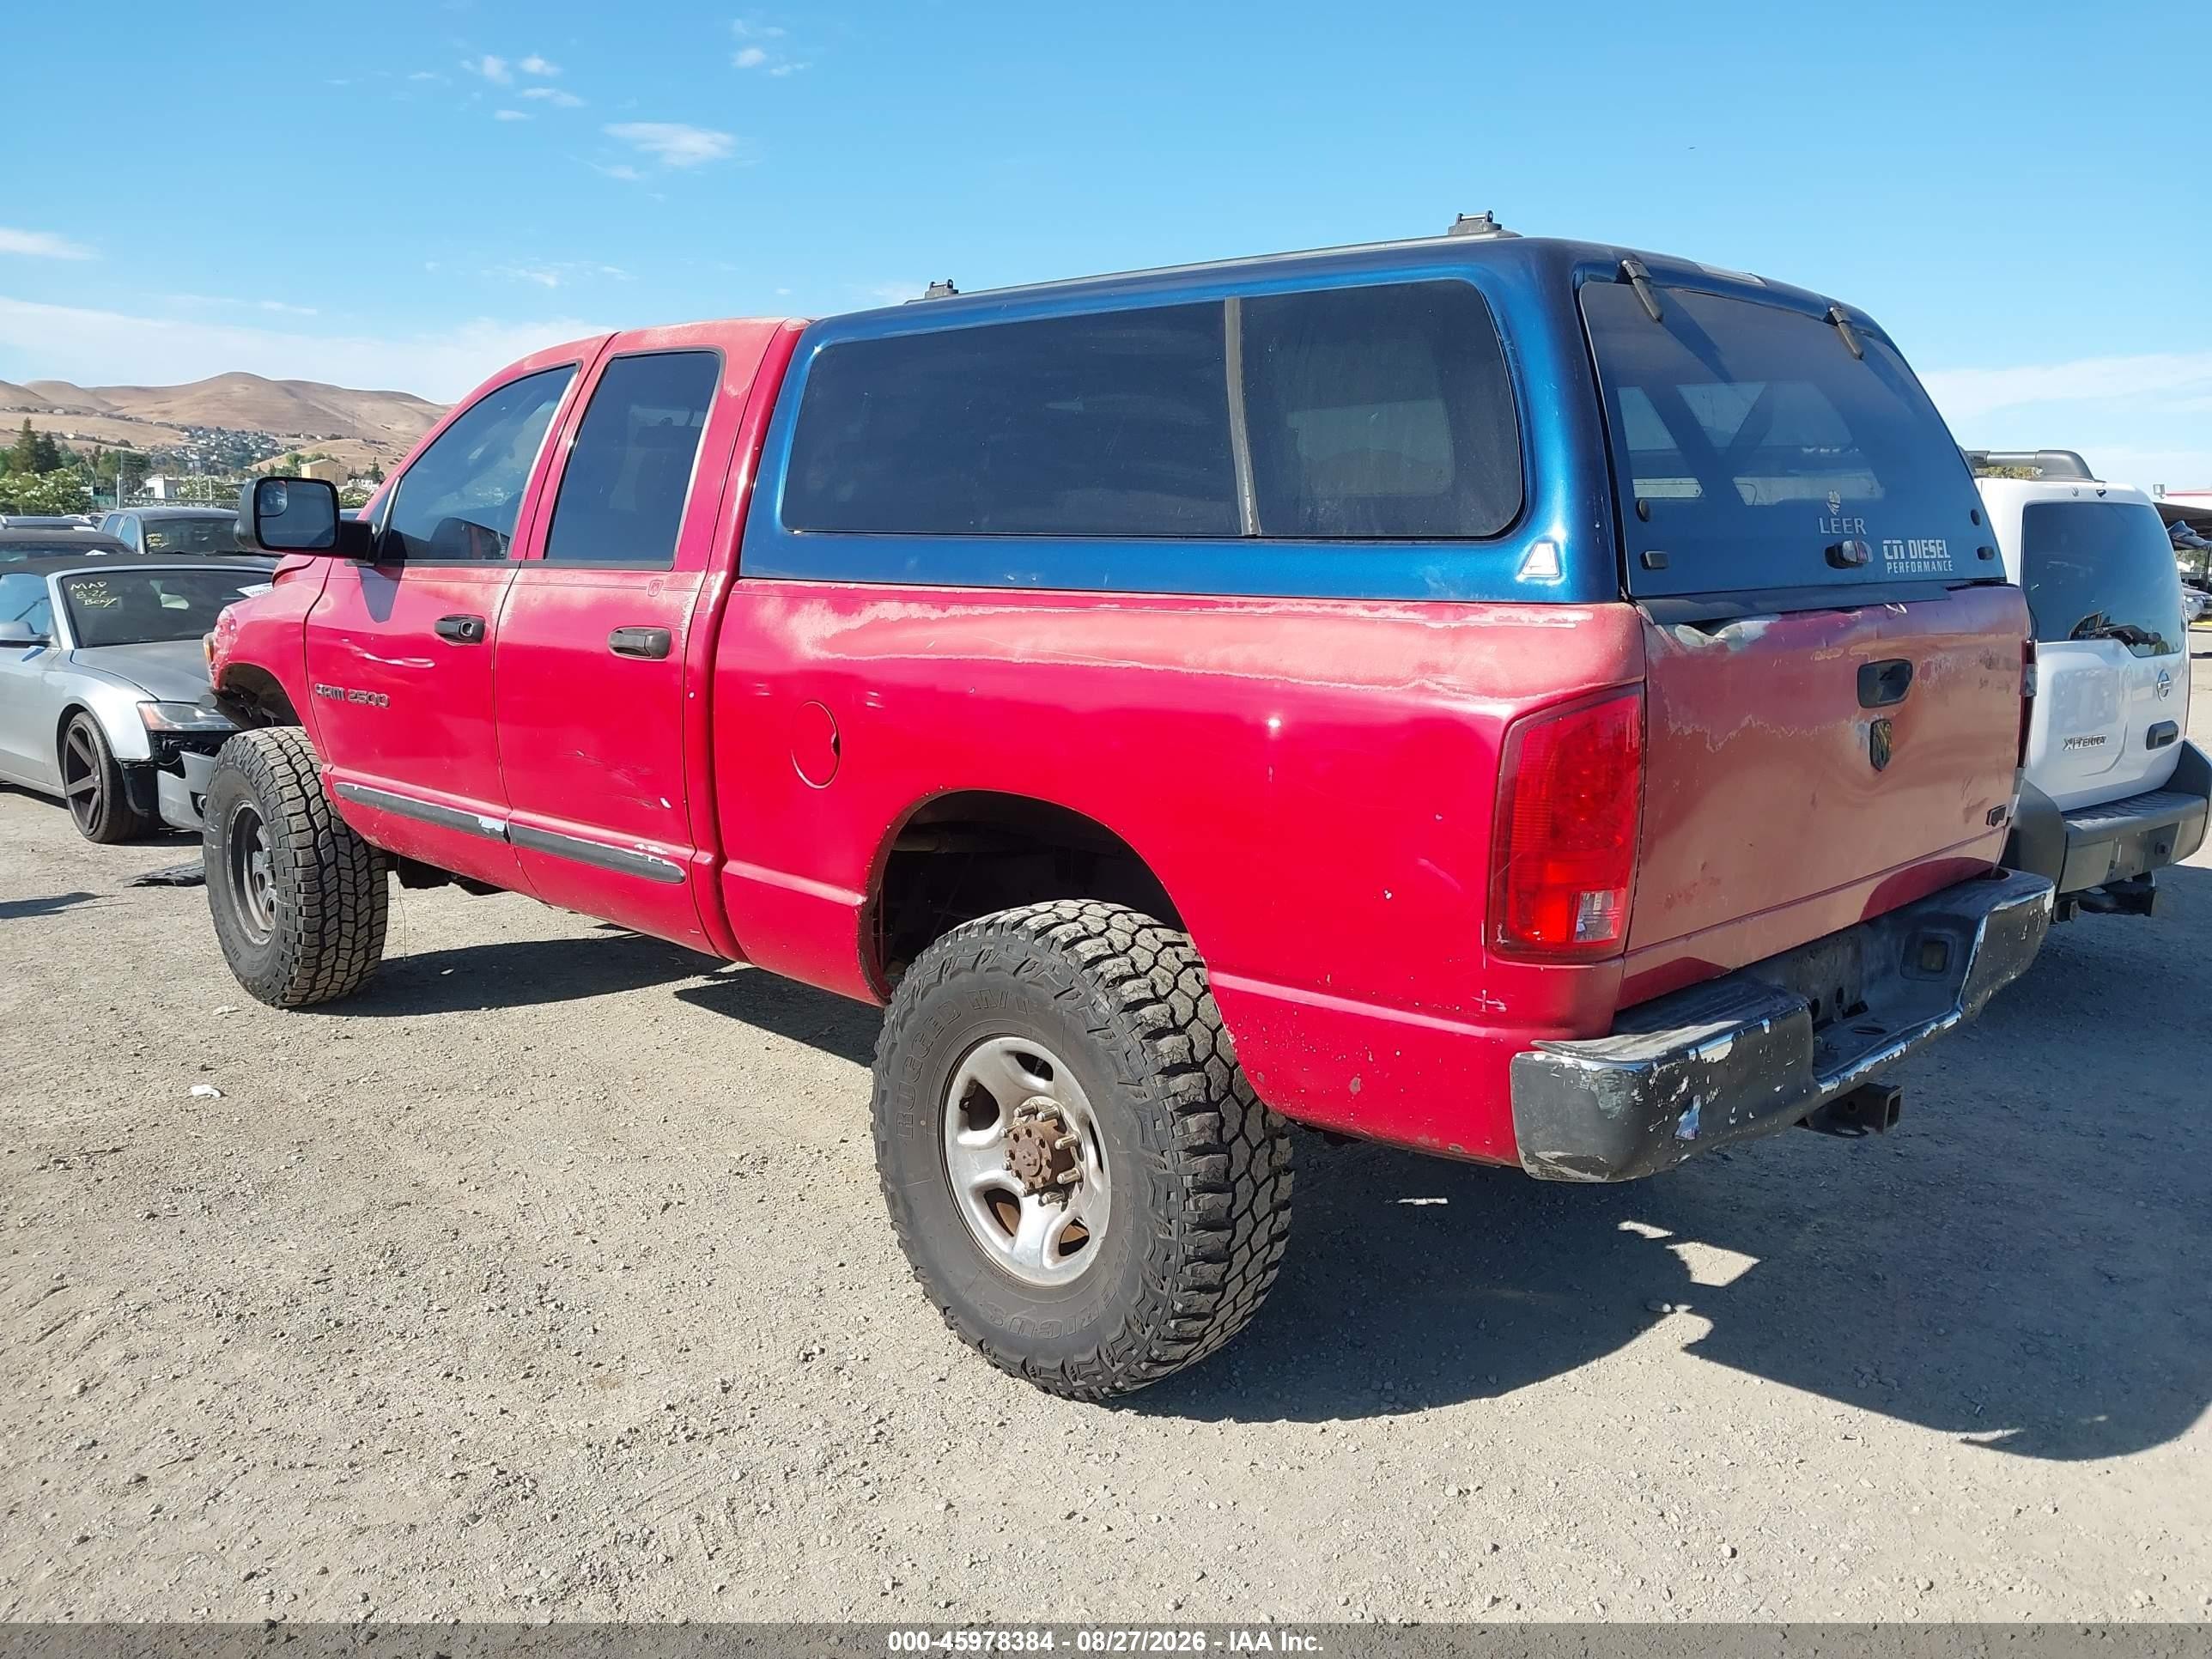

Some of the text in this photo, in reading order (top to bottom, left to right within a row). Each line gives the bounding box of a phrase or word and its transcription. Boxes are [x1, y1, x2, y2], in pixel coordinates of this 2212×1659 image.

[1819, 517, 1867, 535] LEER
[1908, 539, 1951, 559] DIESEL
[1887, 560, 1954, 574] PERFORMANCE
[315, 684, 390, 708] RAM 2500
